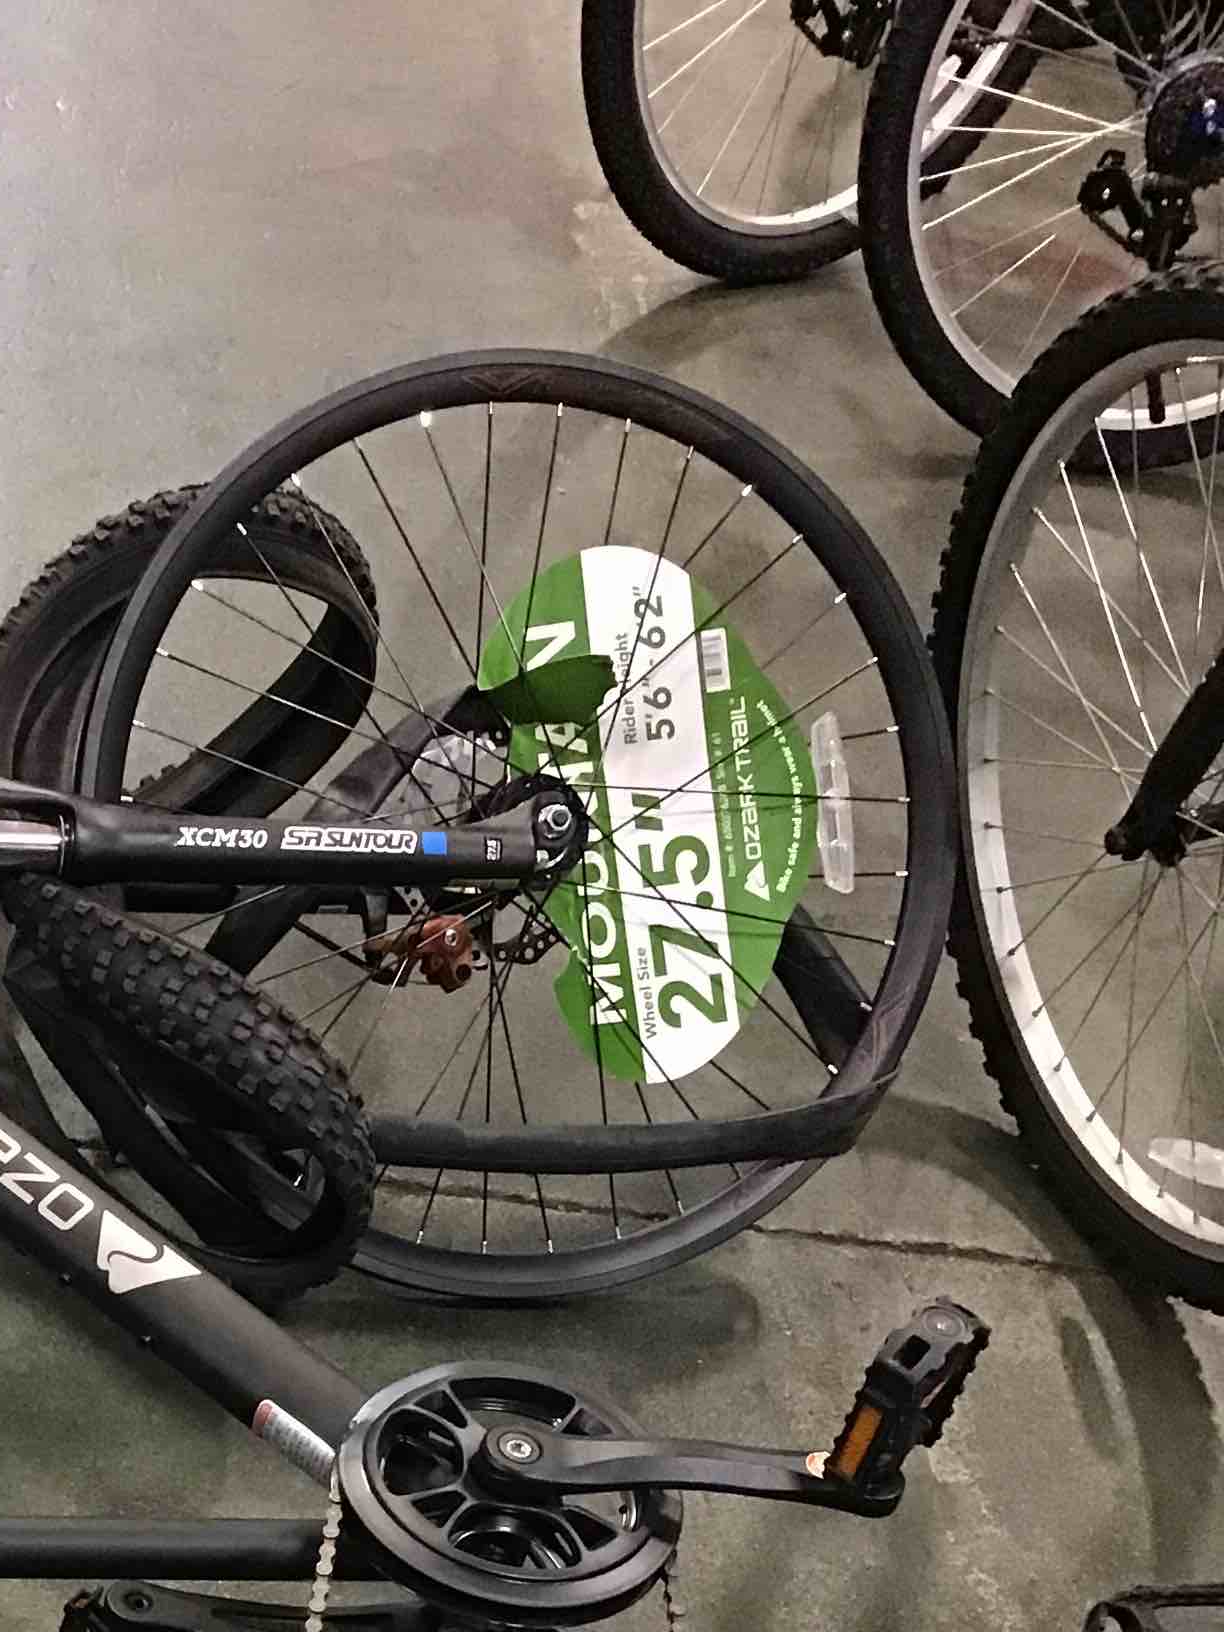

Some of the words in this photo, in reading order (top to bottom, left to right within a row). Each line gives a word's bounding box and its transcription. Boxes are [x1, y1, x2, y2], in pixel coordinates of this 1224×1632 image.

[621, 699, 637, 745] Rider
[782, 745, 796, 774] wear
[174, 826, 269, 849] XCM30
[526, 620, 628, 1026] MOUTAN
[792, 817, 801, 840] and
[787, 841, 799, 867] safe
[776, 867, 793, 894] Bike
[631, 792, 728, 1029] 27.5"
[637, 947, 651, 981] Size
[639, 986, 657, 1040] Wheel
